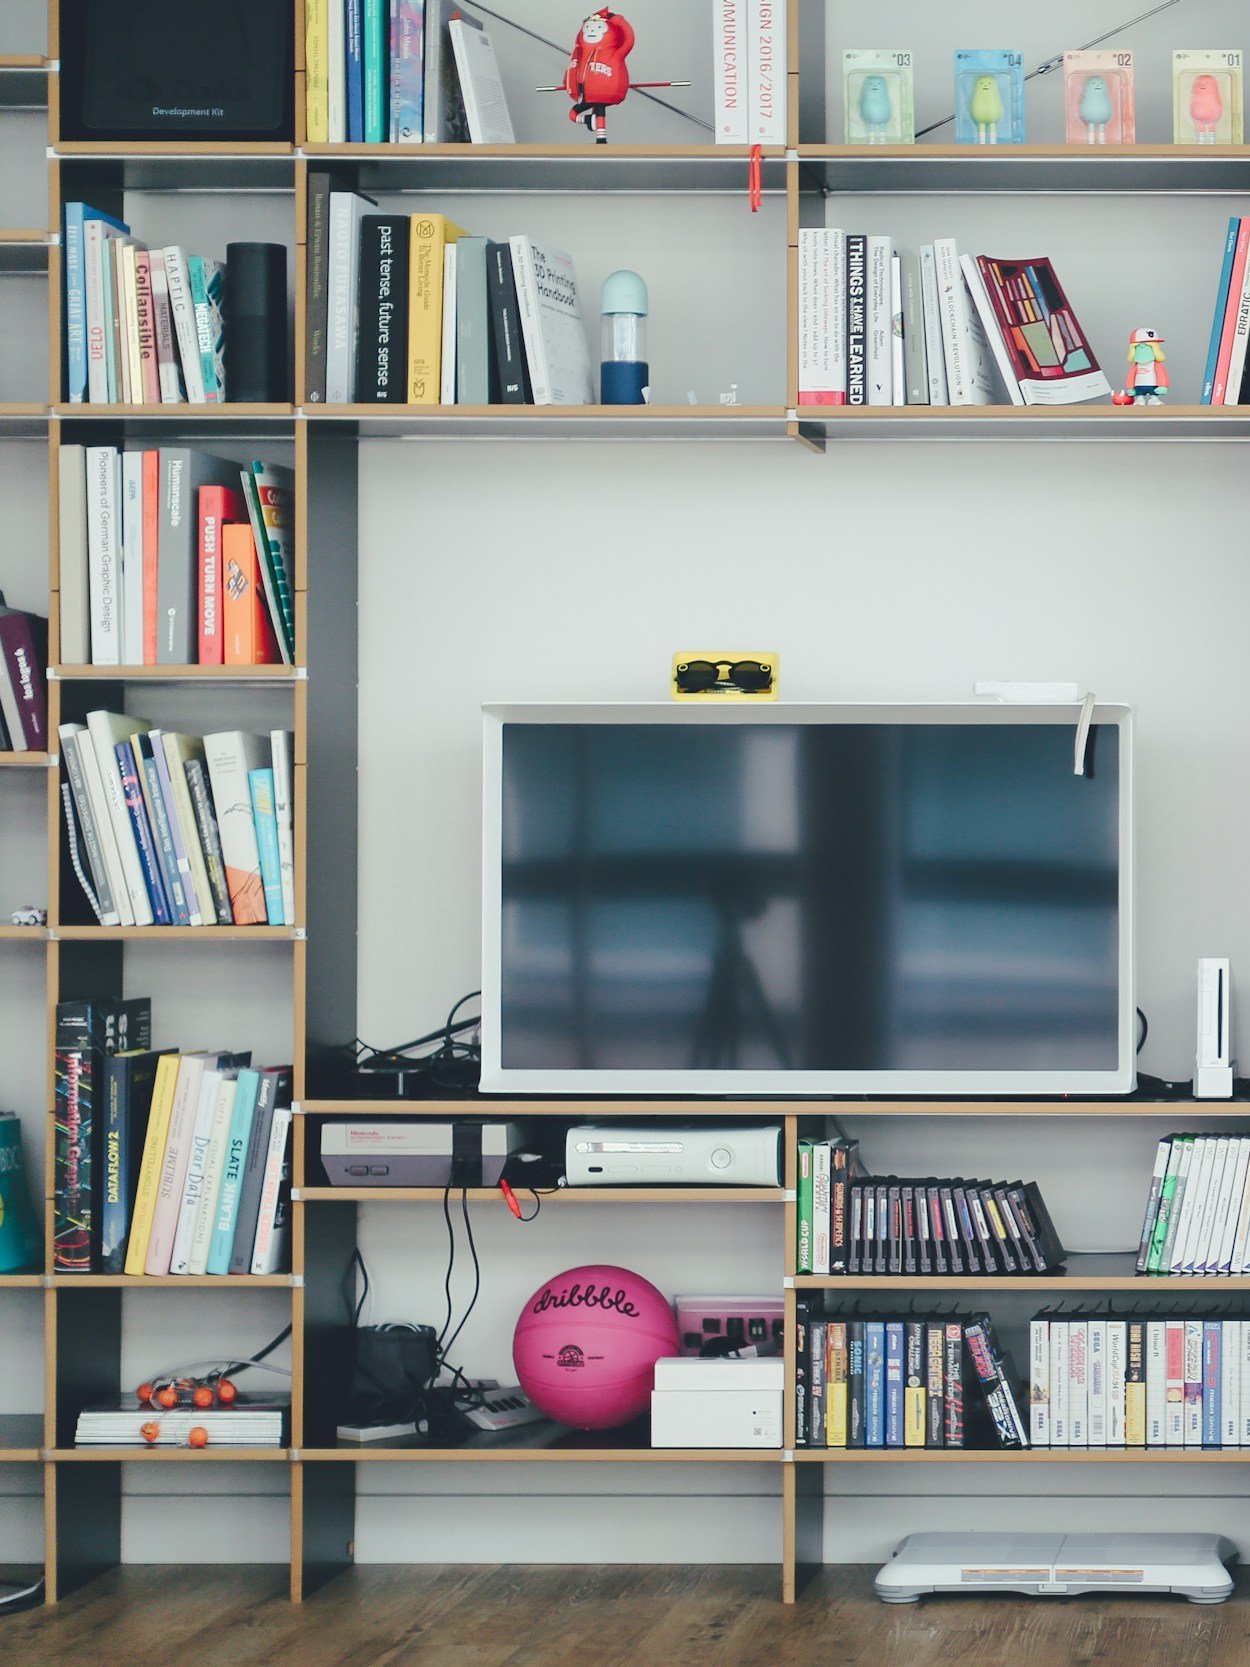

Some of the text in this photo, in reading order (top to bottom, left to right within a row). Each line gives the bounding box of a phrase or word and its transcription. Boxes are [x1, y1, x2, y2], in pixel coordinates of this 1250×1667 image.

[1116, 53, 1131, 66] 02
[152, 106, 224, 119] Development Kit
[531, 245, 546, 264] The
[800, 231, 809, 245] Why
[166, 253, 185, 312] HAPTIC
[334, 208, 350, 351] NAOTO FUKASAWA
[534, 263, 576, 296] 3D Printing
[537, 280, 575, 308] Handbook
[800, 269, 808, 282] your
[850, 242, 864, 297] THINGS
[136, 264, 153, 359] Collapsible
[160, 302, 170, 350] MATERIALS
[195, 303, 212, 353] MEGATECH
[377, 226, 394, 387] past tense, future sense
[853, 305, 864, 333] HAVE
[802, 351, 808, 359] on
[948, 295, 962, 386] BLOCKCHAIN REVOLUTION
[849, 334, 864, 405] LEARNED
[170, 459, 183, 528] Humanscale
[99, 451, 113, 634] Pioneers of German Graphic Design
[204, 516, 216, 637] PUSH TURN MOVE
[67, 1051, 83, 1143] Information
[258, 1078, 270, 1109] Identity
[161, 1145, 180, 1200] SUBLIME
[185, 1135, 211, 1206] Dear Data
[226, 1138, 243, 1180] SLATE
[217, 1182, 237, 1232] BLANK
[800, 1219, 810, 1269] WORLD CUP
[533, 1284, 640, 1318] dribbble
[853, 1340, 862, 1375] SONIC
[1093, 1331, 1101, 1353] SEGA
[947, 1342, 955, 1402] TERMINATOR
